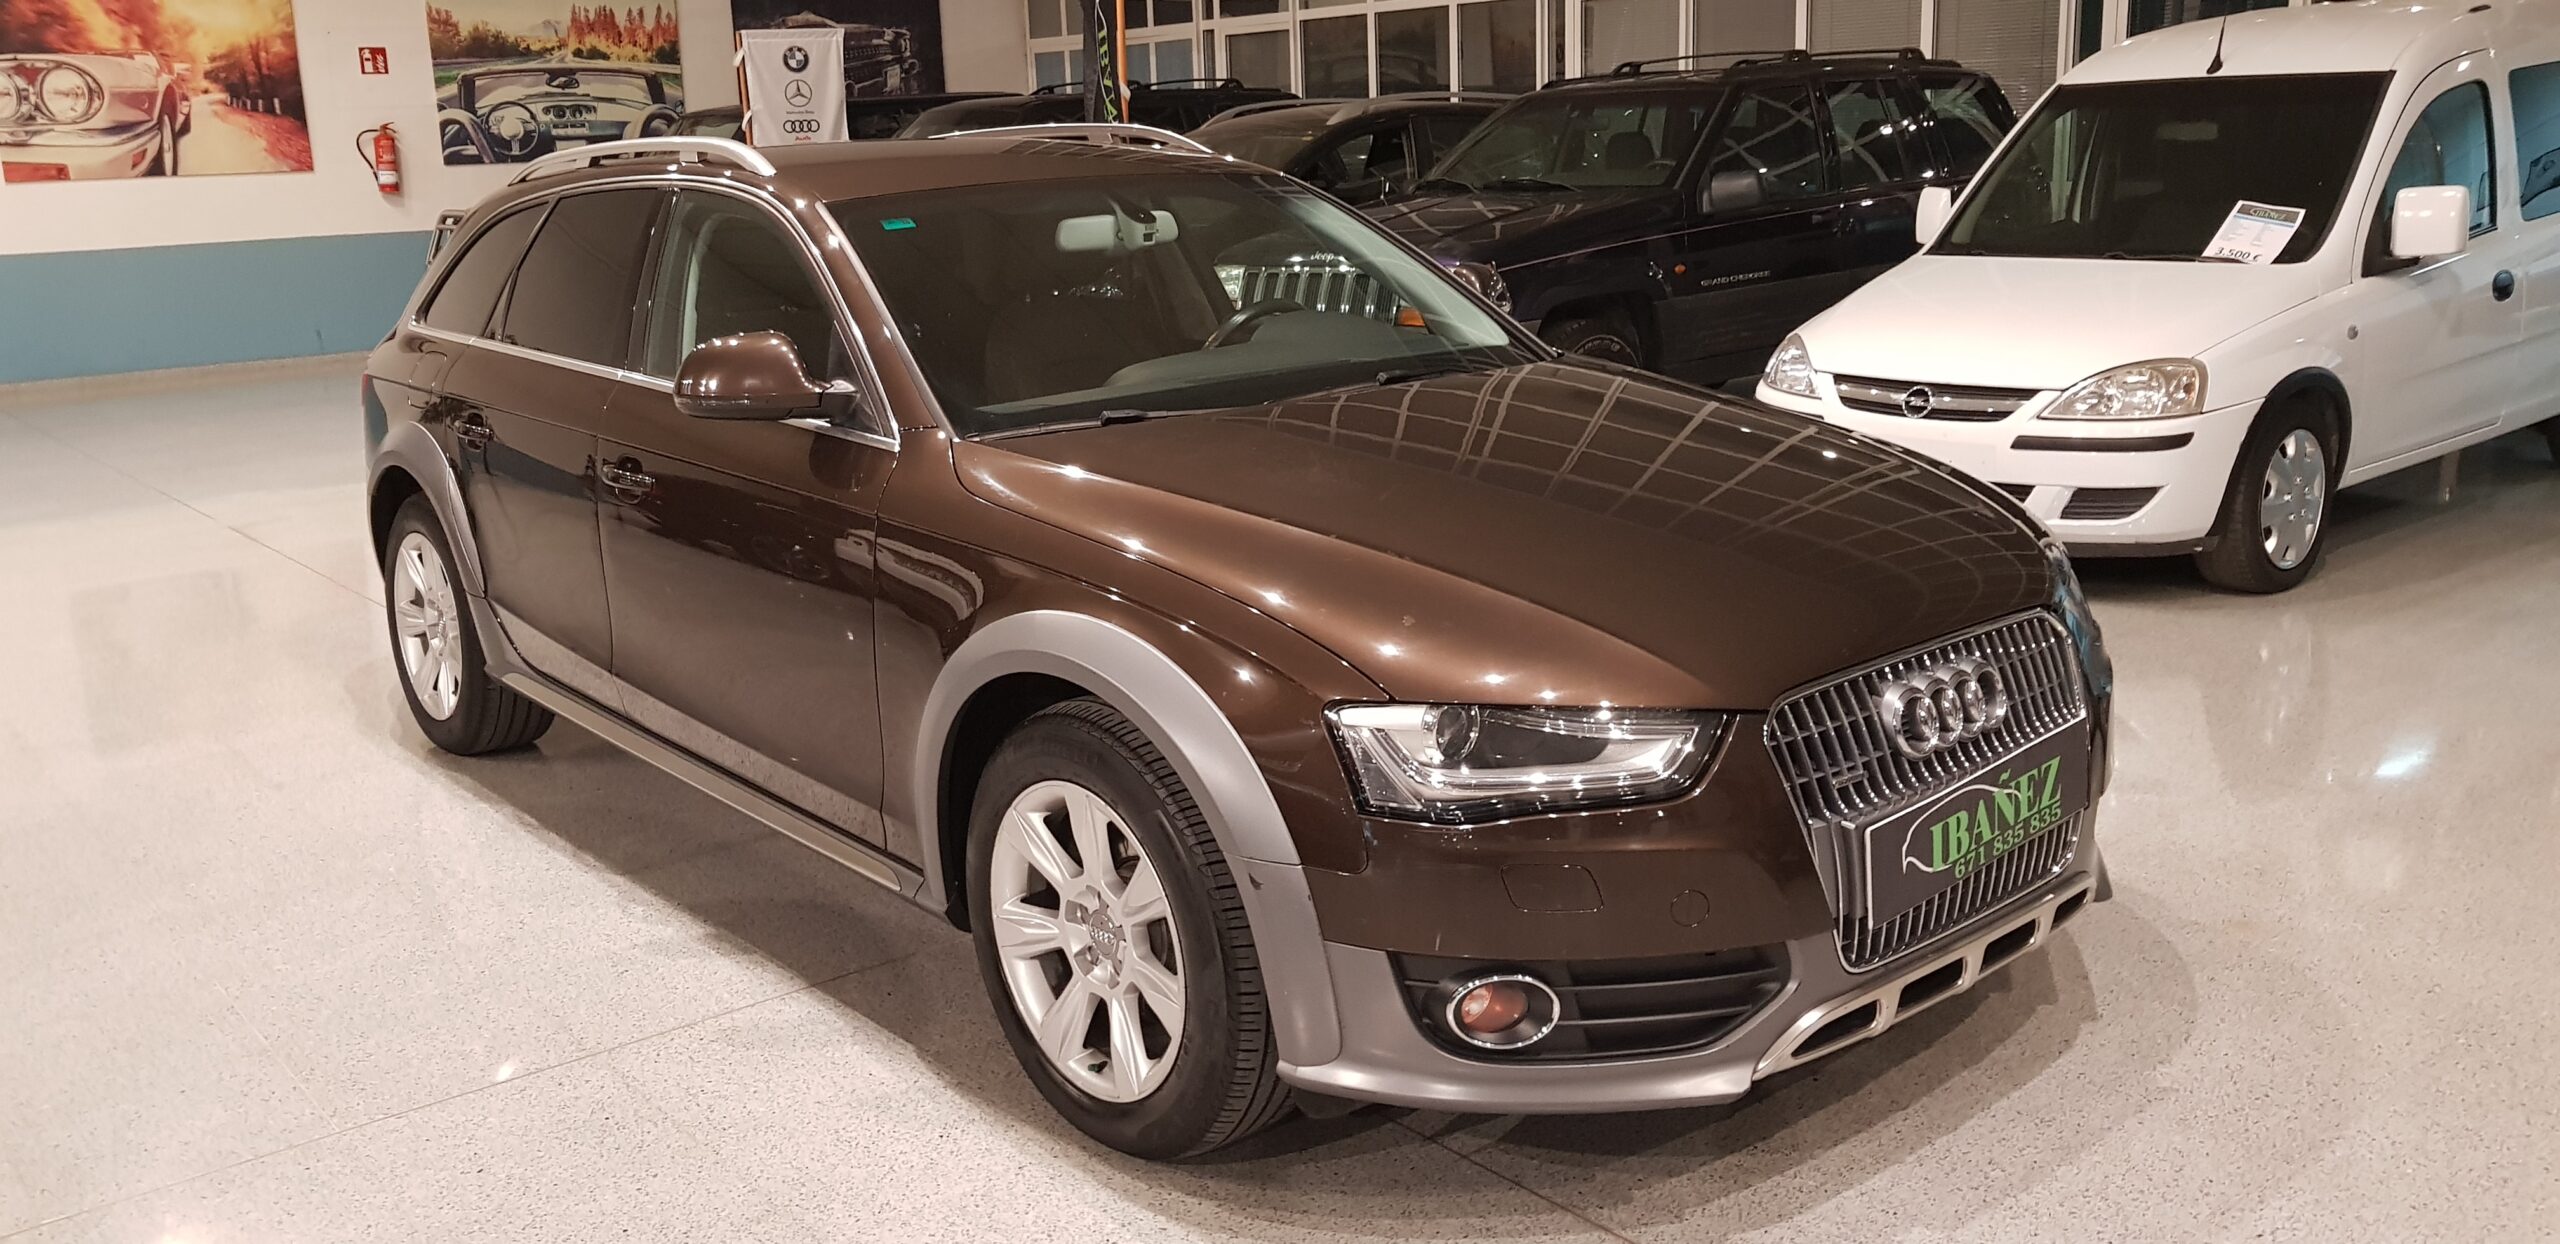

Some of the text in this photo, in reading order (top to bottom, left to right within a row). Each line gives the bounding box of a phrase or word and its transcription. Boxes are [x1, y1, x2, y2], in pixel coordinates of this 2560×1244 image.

[1310, 251, 1334, 263] Jeep
[2214, 247, 2251, 259] 3.500
[1930, 756, 2062, 872] IBAÑEZ
[1955, 801, 2061, 878] 671 835 835
